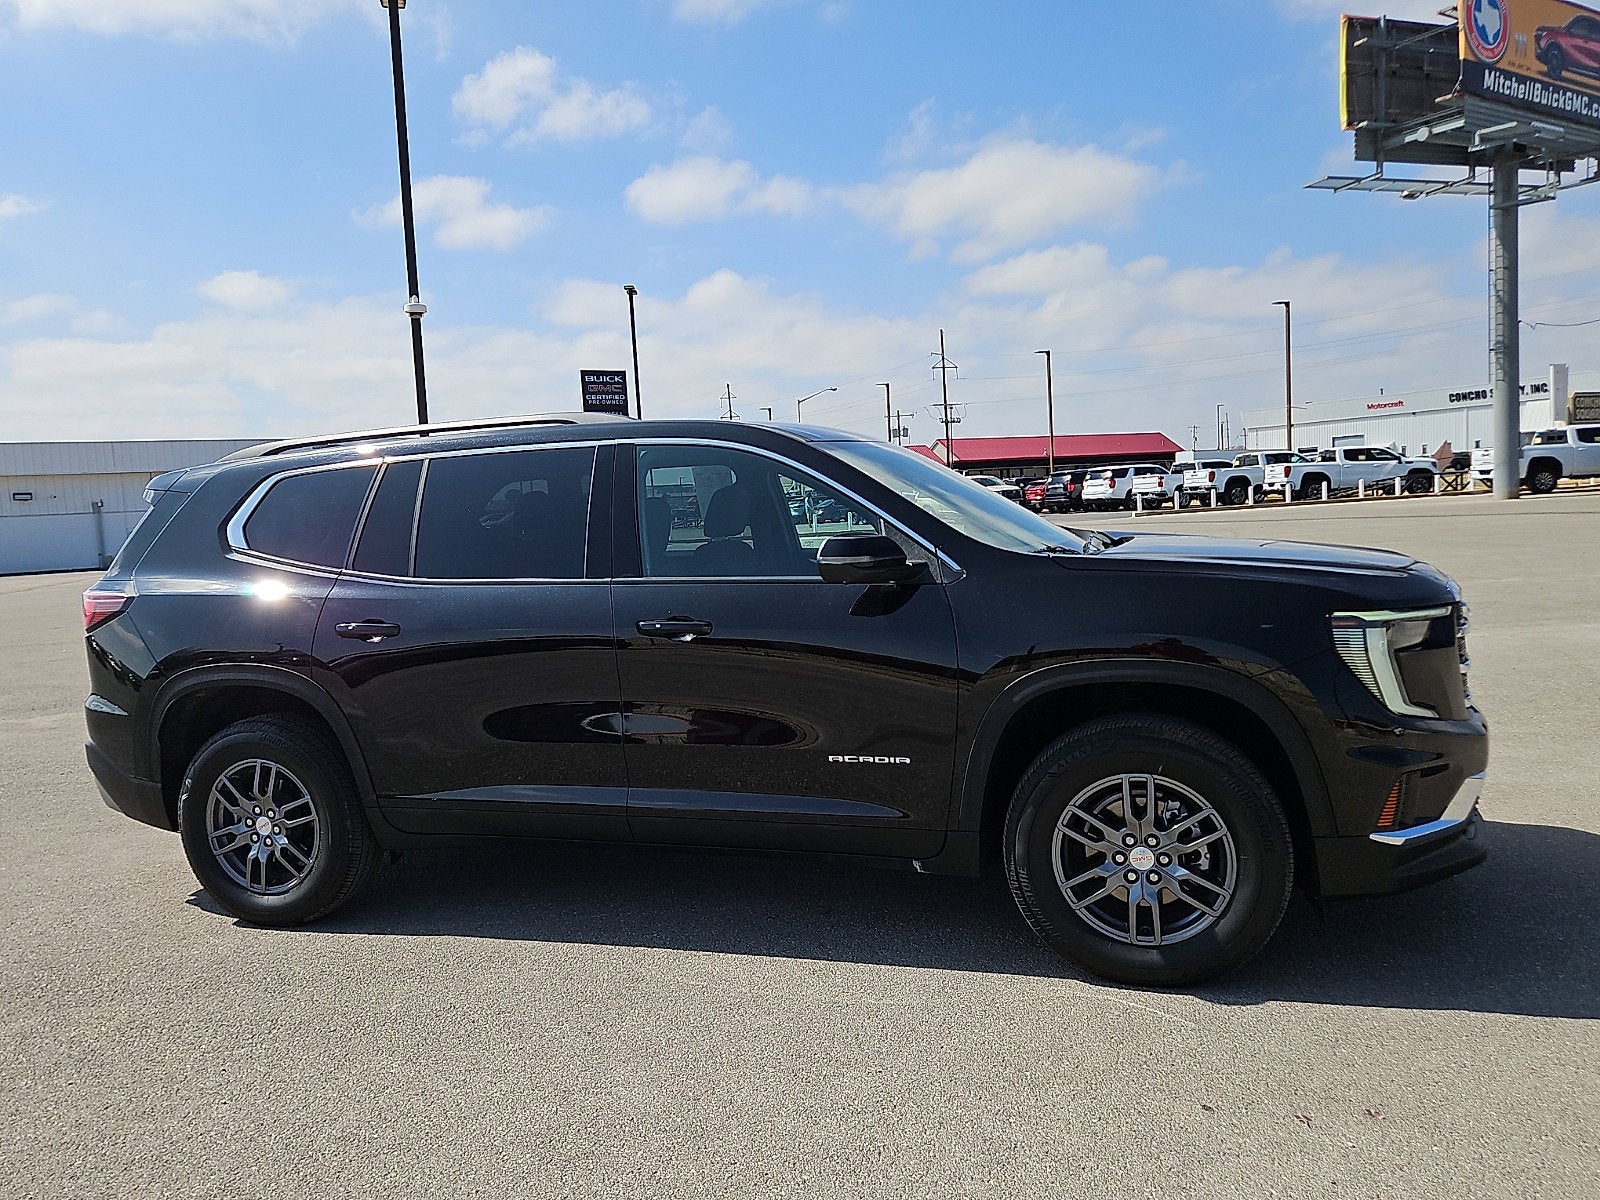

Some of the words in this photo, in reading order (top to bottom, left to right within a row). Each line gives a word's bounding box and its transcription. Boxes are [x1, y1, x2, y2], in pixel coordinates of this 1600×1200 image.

[1448, 389, 1488, 403] CONCHO
[1530, 382, 1550, 394] INC.
[1366, 400, 1404, 410] Motorcraft
[828, 755, 911, 764] ACADIA
[1131, 855, 1153, 863] GMC
